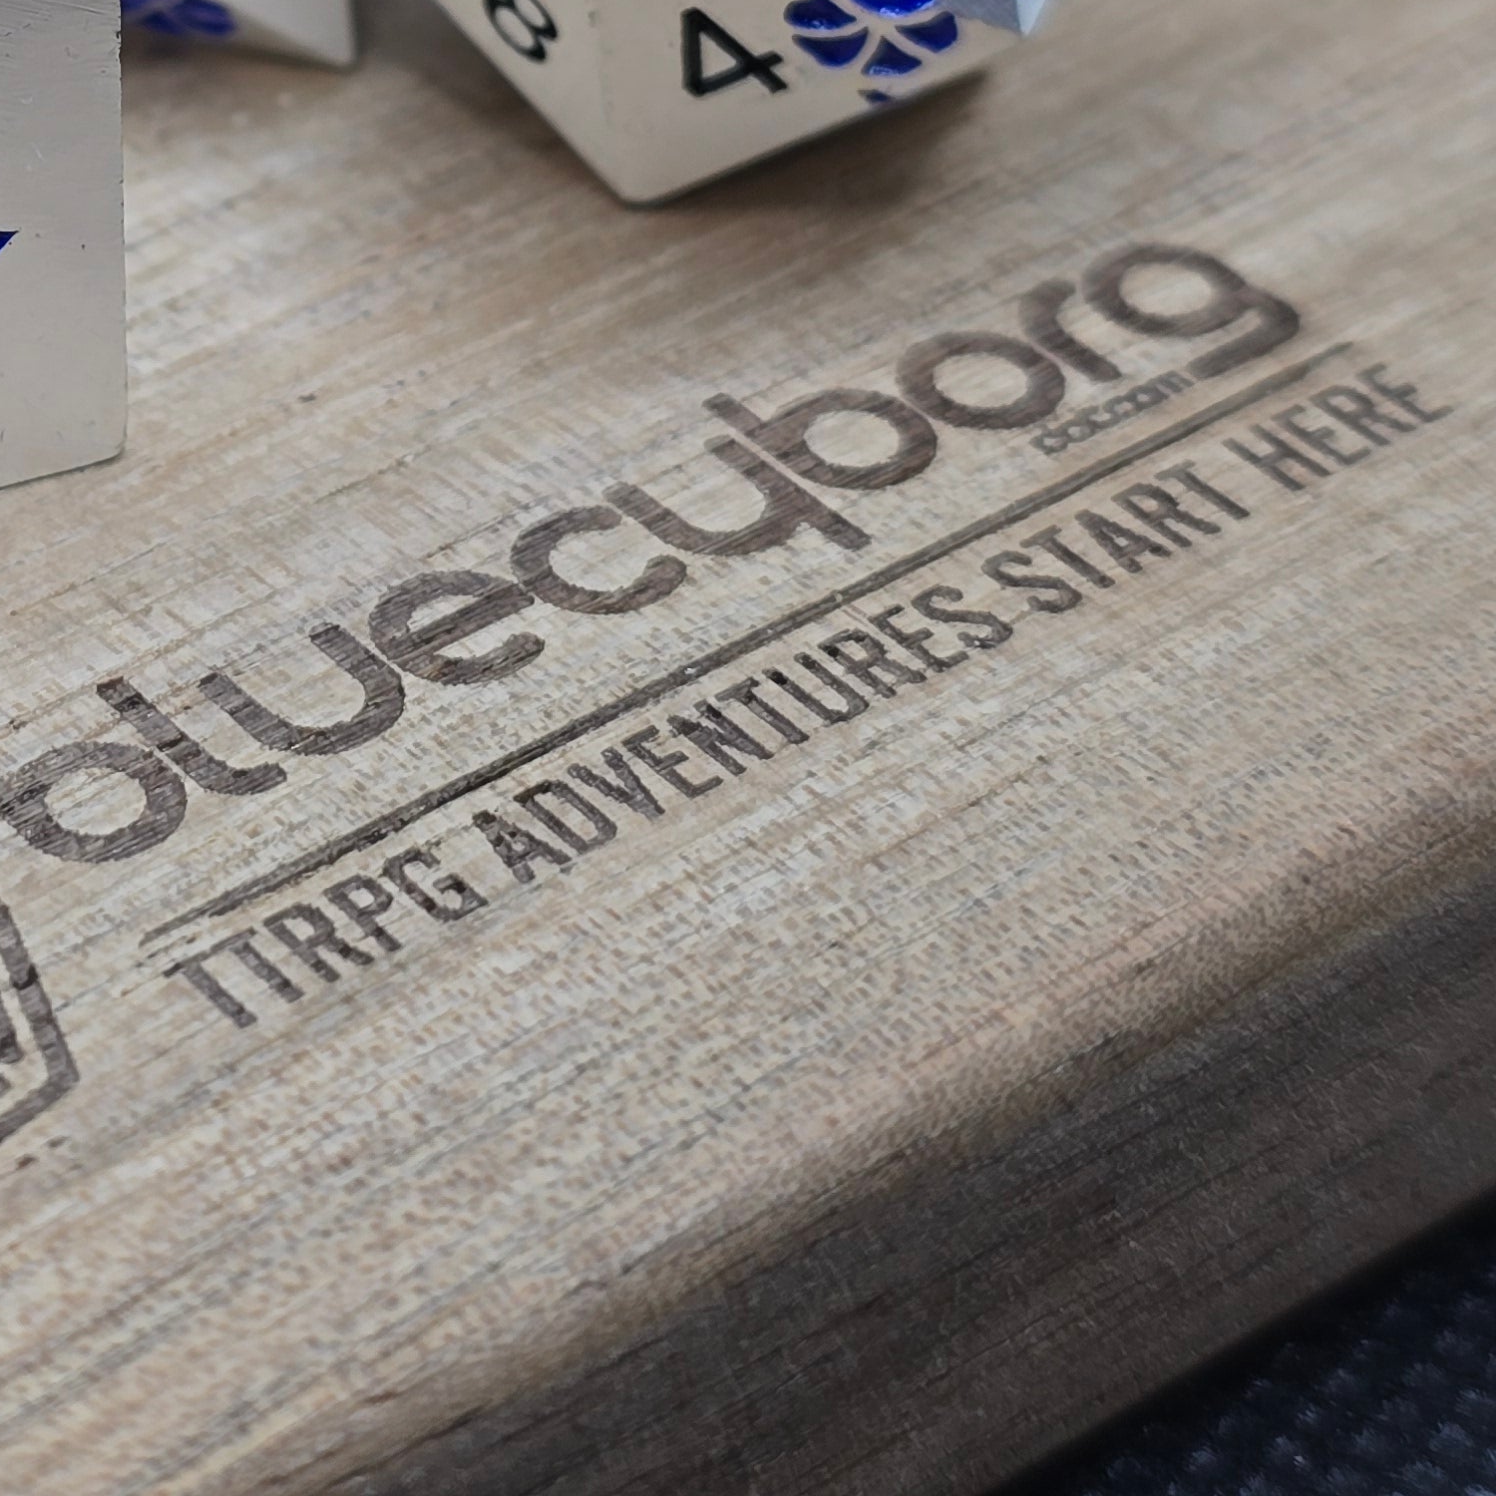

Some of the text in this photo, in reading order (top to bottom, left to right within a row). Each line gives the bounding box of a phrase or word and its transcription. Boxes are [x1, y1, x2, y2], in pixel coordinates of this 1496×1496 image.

[681, 5, 789, 99] 4
[163, 361, 1452, 1030] TTRPG ADVENTURES START HERE
